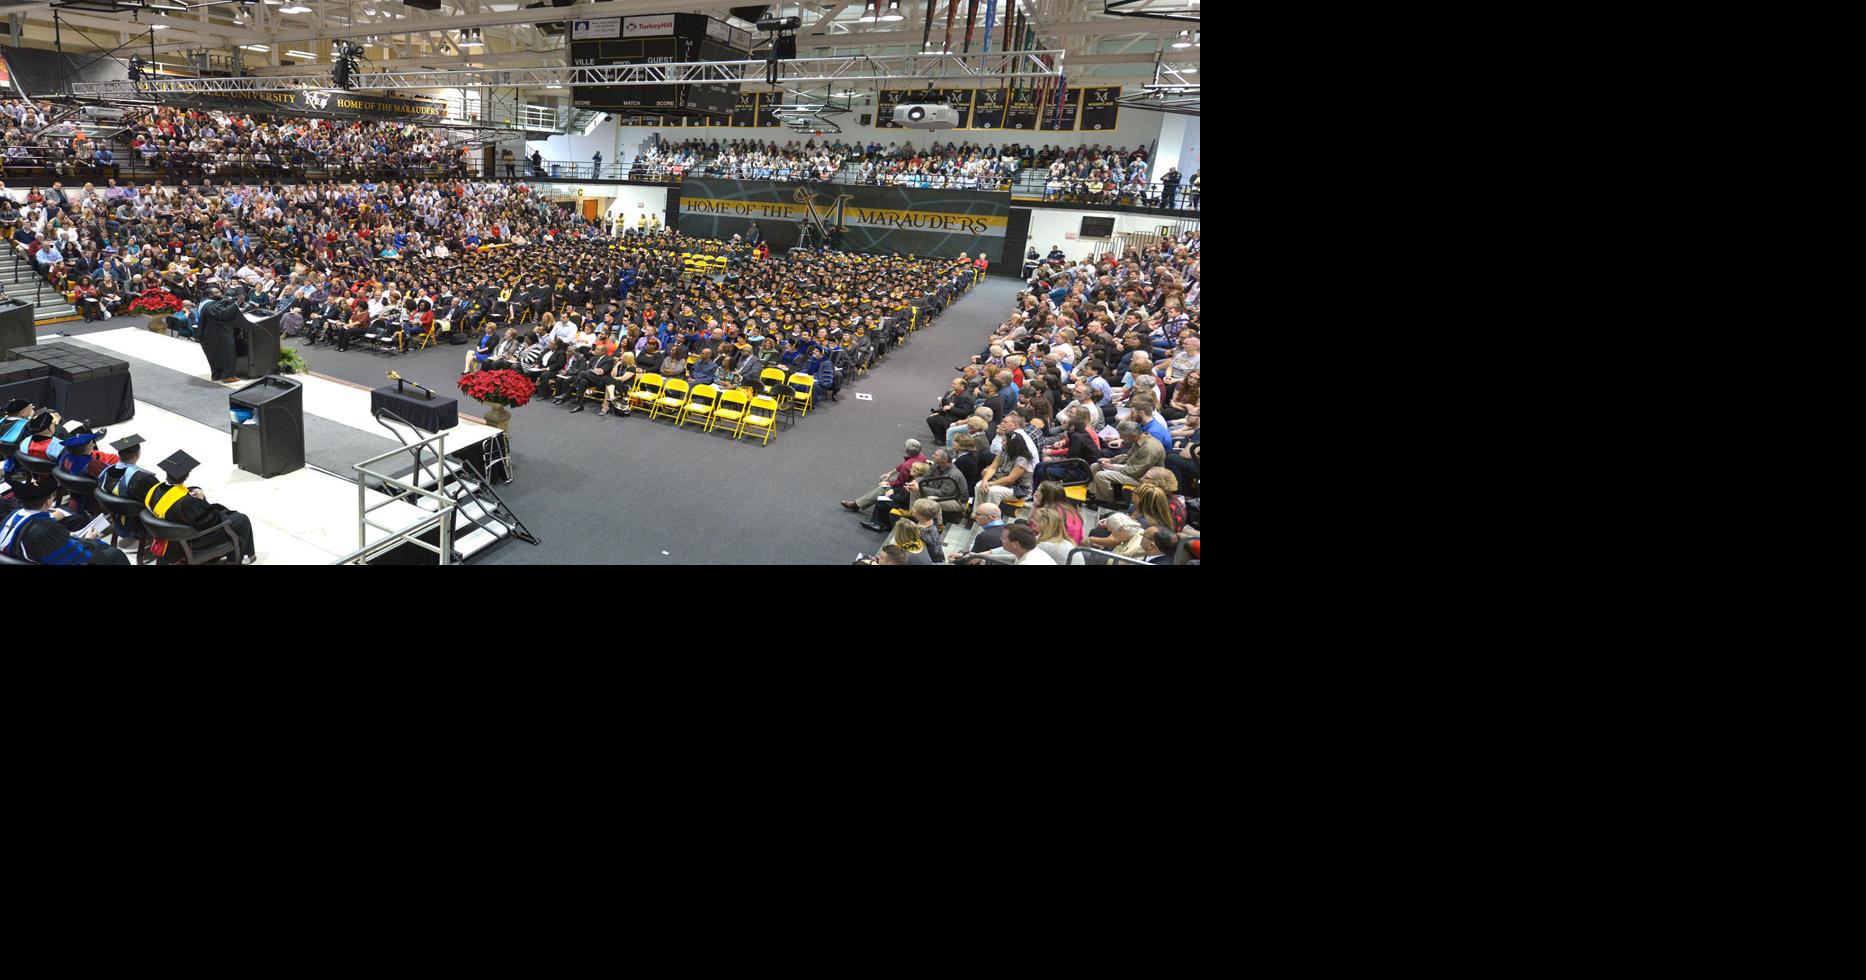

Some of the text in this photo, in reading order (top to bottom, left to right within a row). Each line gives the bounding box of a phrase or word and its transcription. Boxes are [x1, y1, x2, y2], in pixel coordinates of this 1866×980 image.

[574, 56, 673, 66] VILLE GUEST
[230, 90, 296, 104] UNIVERSITY
[337, 99, 439, 116] HOME OF THE MARAUDERS
[687, 199, 795, 219] HOME OF THE
[856, 208, 989, 236] MARAUDERS
[1161, 225, 1169, 236] D
